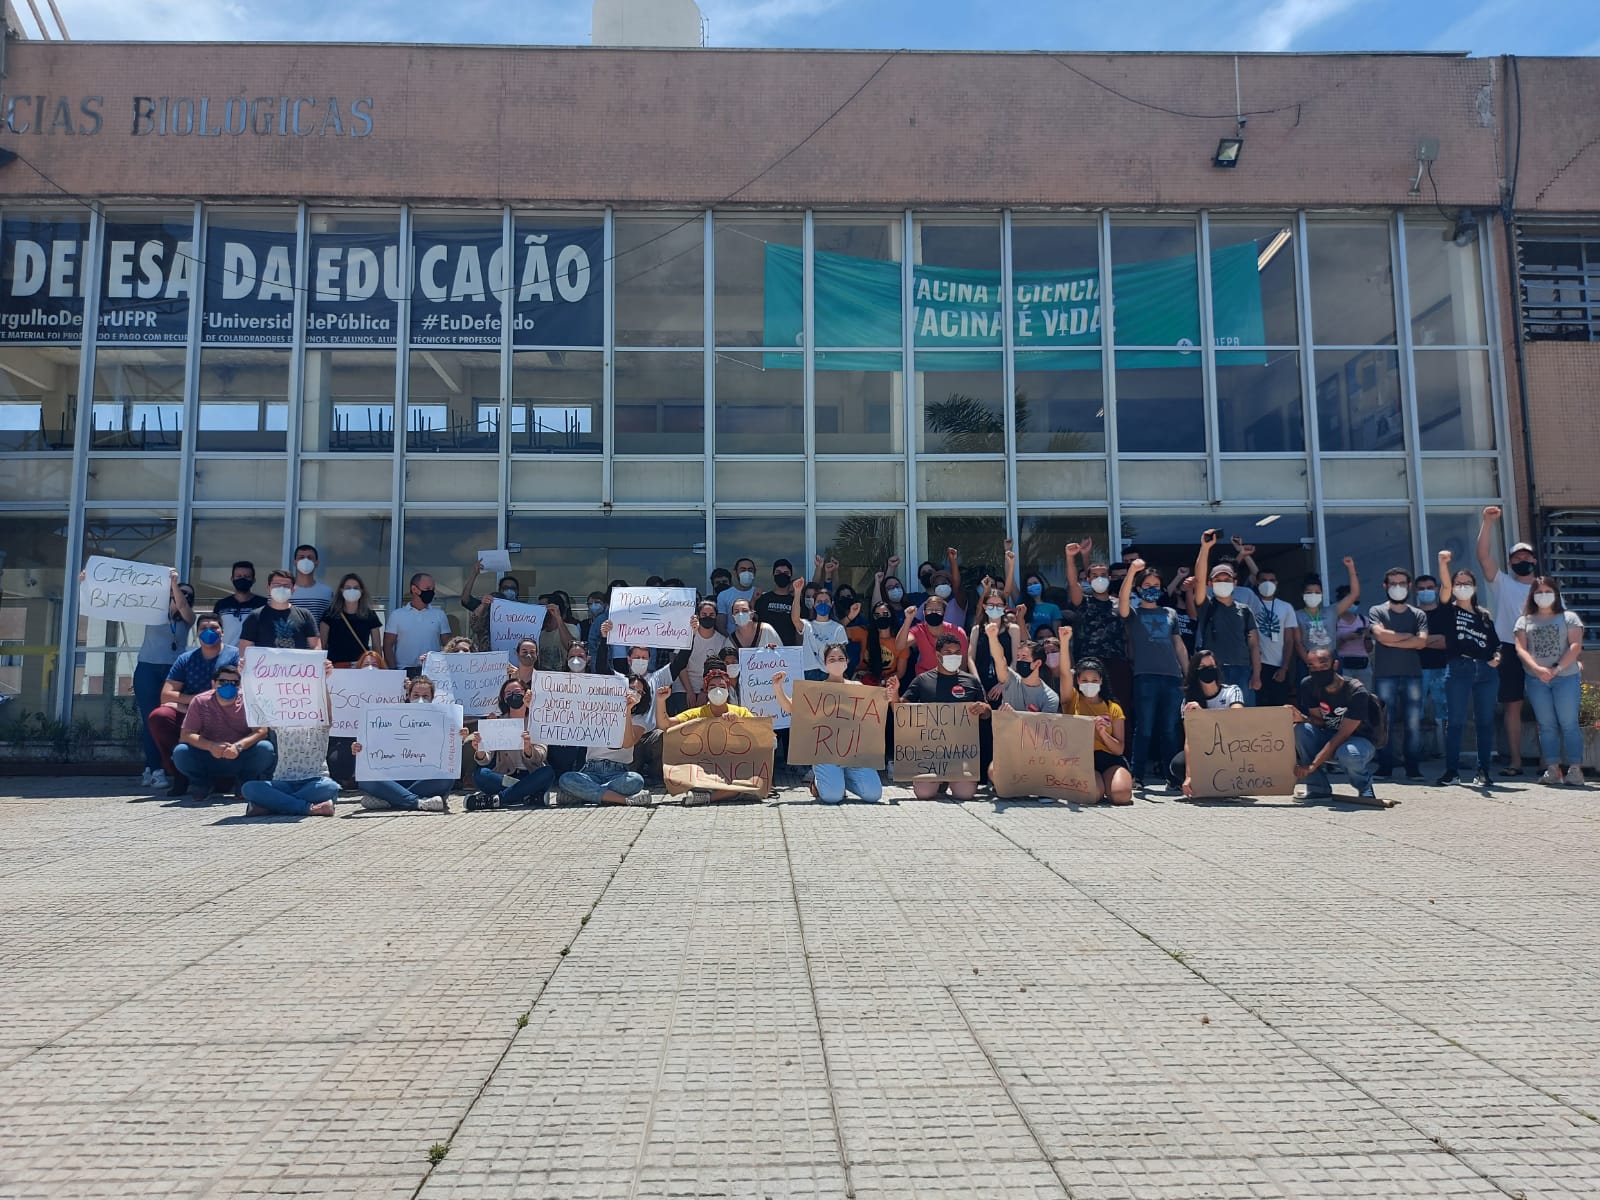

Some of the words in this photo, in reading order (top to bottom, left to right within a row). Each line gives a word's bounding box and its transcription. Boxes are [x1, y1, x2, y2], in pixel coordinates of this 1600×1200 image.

[0, 96, 104, 137] CIAS
[132, 88, 374, 137] BIOLÓGICAS
[222, 242, 295, 300] DA
[316, 234, 591, 312] EDUCAÇÃO
[914, 278, 988, 303] ACINA
[421, 313, 535, 331] #EuDefedo
[1019, 304, 1033, 337] É
[8, 332, 45, 340] MATERIAL
[218, 335, 286, 343] COLABORADORES
[413, 335, 450, 344] TÉCNICOS
[276, 682, 312, 696] TECH
[280, 697, 313, 709] POP
[804, 693, 881, 724] VOLTA
[277, 708, 325, 722] TUDO!
[540, 725, 611, 746] ENTENDAM!
[814, 724, 861, 758] RU!
[920, 729, 947, 741] FICA
[895, 744, 978, 761] BOLSONARO
[1238, 758, 1255, 773] da
[1212, 768, 1274, 793] Ciência
